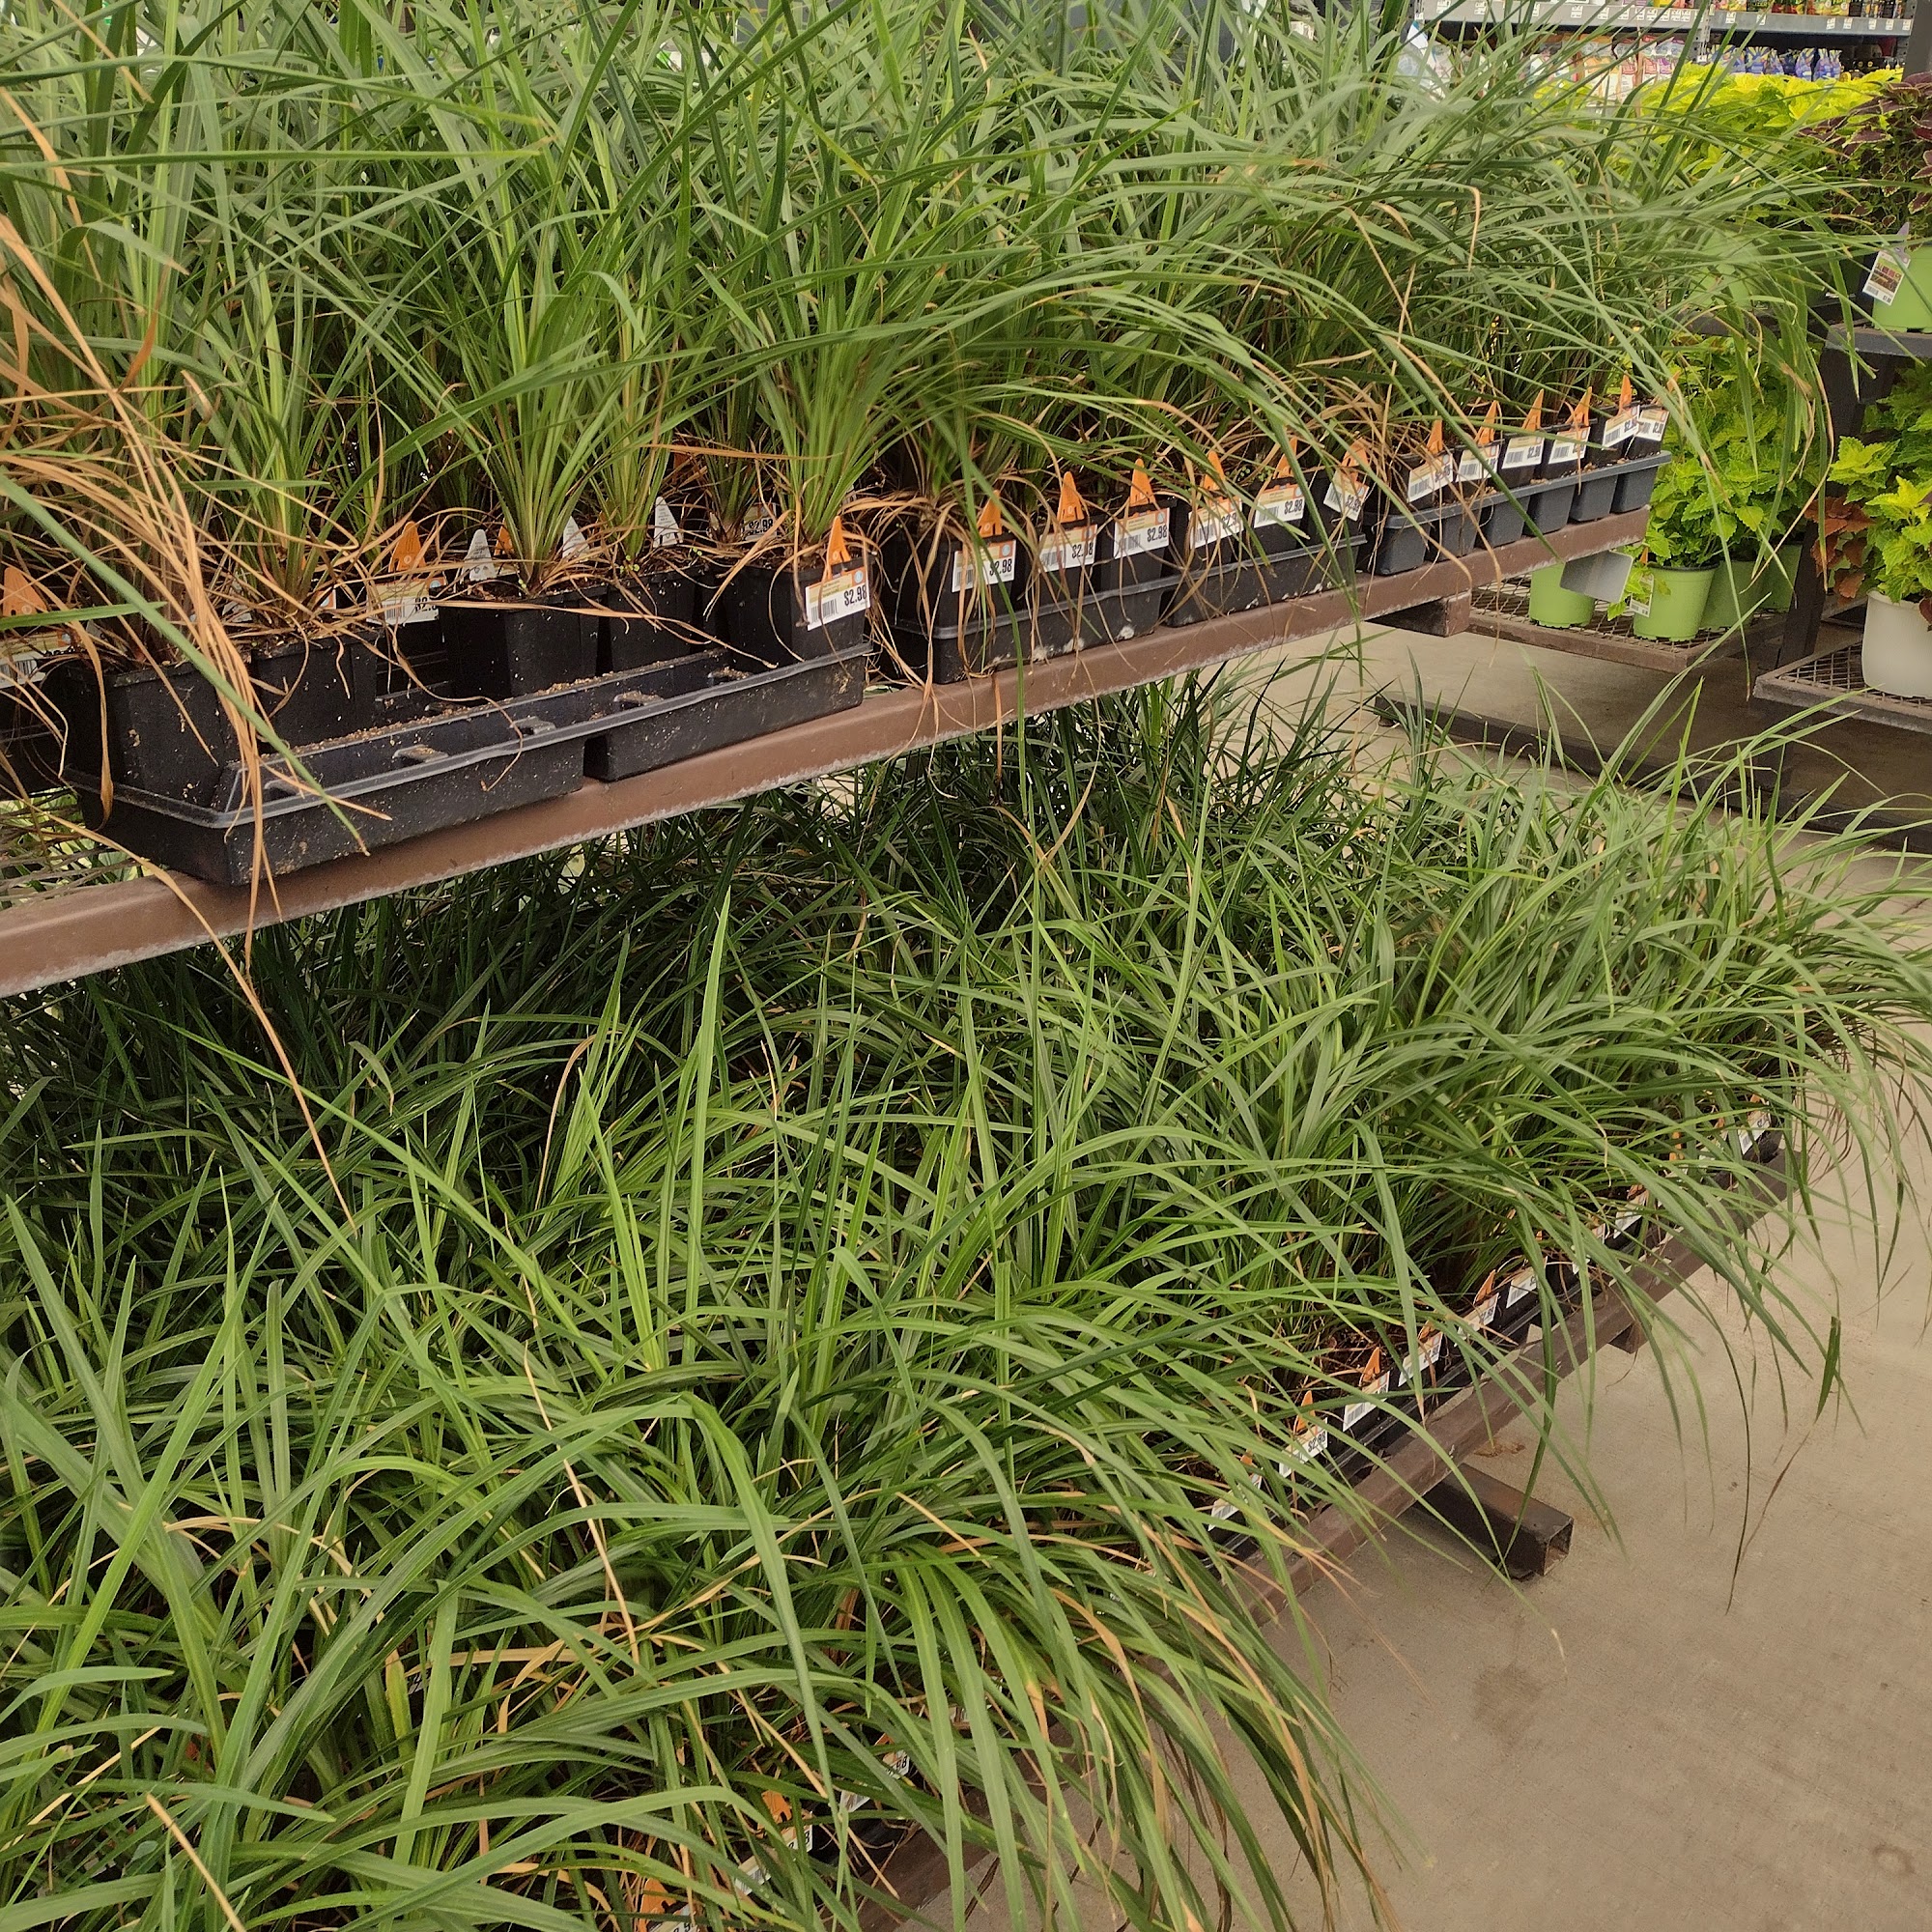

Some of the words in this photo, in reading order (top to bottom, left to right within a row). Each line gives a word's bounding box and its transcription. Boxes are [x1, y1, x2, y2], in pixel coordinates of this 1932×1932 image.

[1284, 498, 1303, 515] $2.98
[1147, 525, 1168, 542] $2.98
[1071, 542, 1094, 559] $2.8
[844, 584, 867, 607] $2.98
